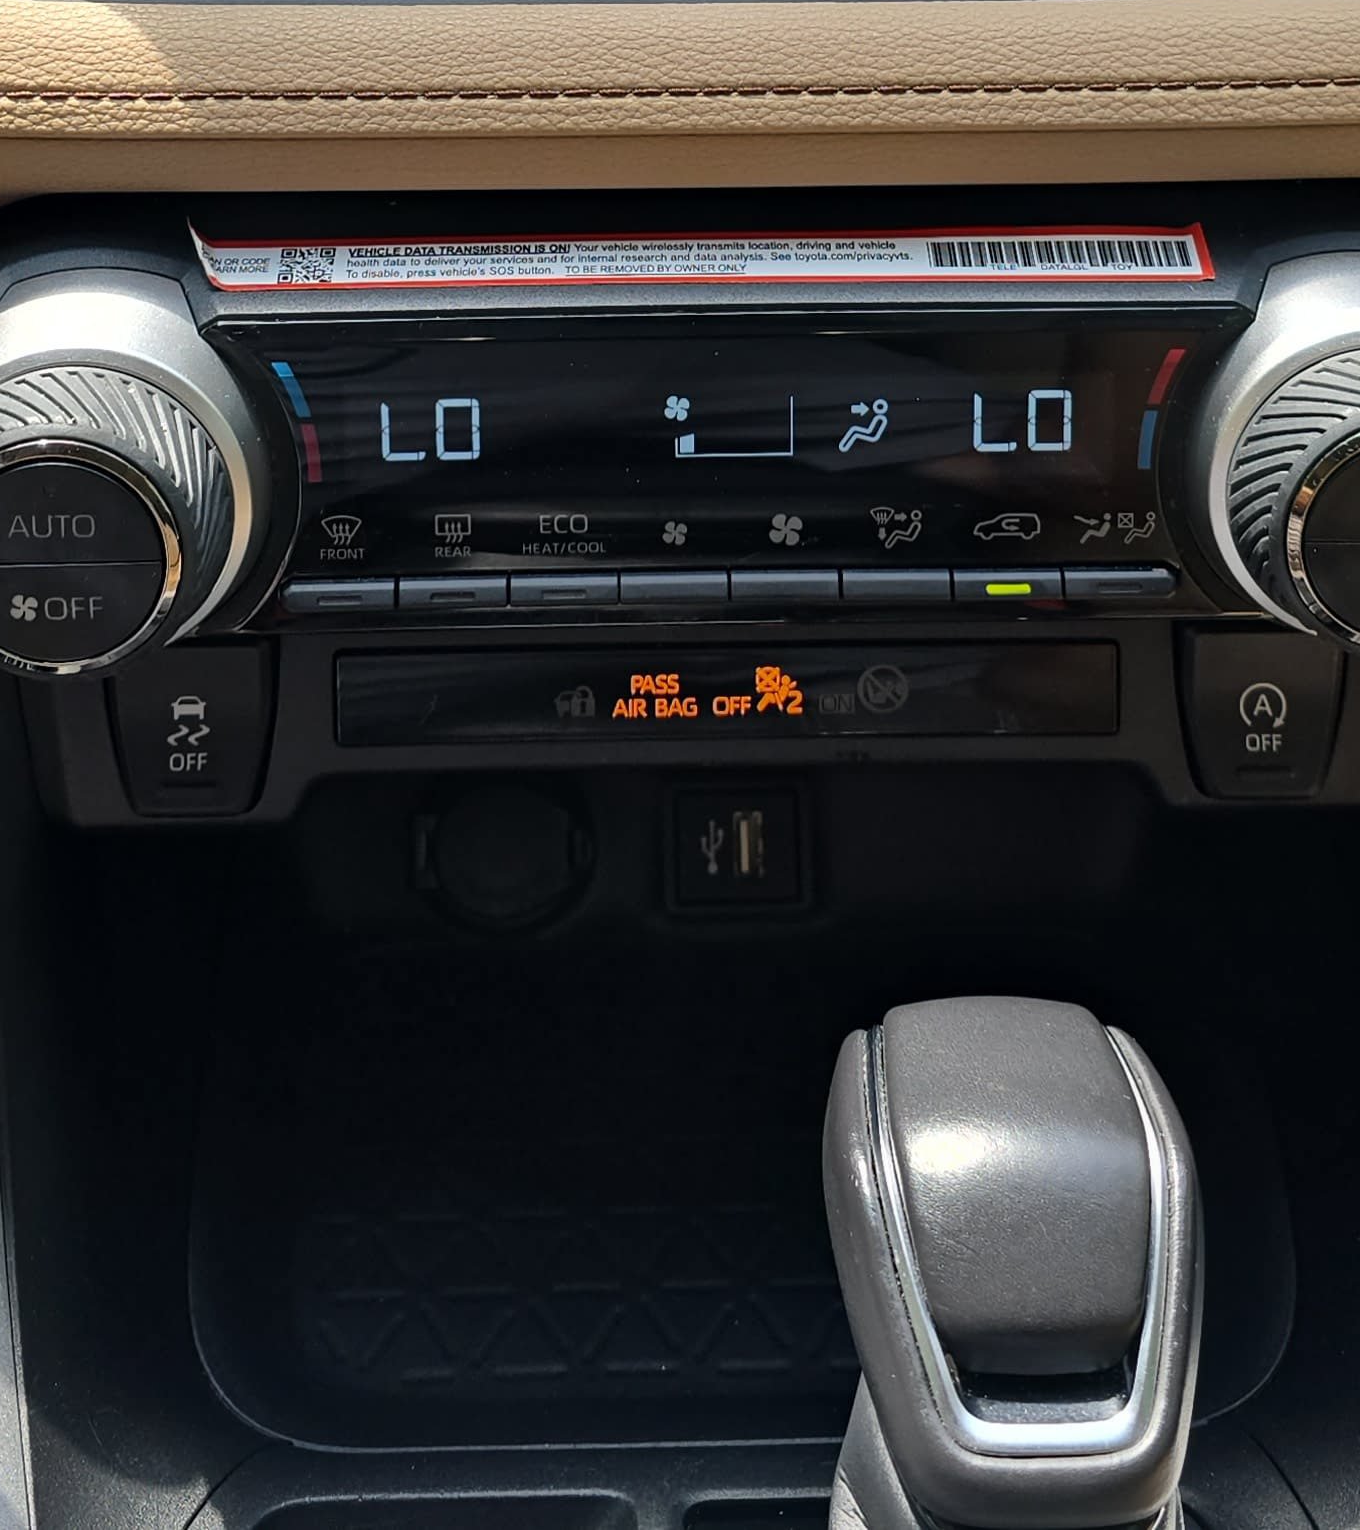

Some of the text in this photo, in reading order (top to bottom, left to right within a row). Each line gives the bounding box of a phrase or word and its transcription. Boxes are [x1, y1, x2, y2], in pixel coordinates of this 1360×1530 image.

[348, 246, 401, 258] VEHICLE
[404, 246, 437, 257] DATA
[438, 244, 532, 256] TRANSMISSION
[534, 243, 546, 254] IS
[574, 243, 599, 253] Your
[601, 242, 639, 252] vehicle
[642, 242, 694, 253] wirelessly
[696, 241, 746, 251] transmits
[748, 240, 793, 251] location,
[796, 240, 832, 251] driving
[835, 240, 855, 250] and
[858, 240, 896, 250] vehicle
[241, 257, 271, 266] CODE
[346, 258, 380, 268] health
[382, 258, 407, 267] data
[410, 257, 421, 266] to
[424, 257, 460, 266] deliver
[463, 257, 487, 267] your
[490, 255, 534, 265] services
[537, 255, 558, 264] and
[560, 254, 575, 263] for
[577, 254, 618, 263] internal
[621, 253, 668, 262] research
[670, 253, 691, 262] and
[693, 252, 718, 262] data
[720, 252, 768, 262] analysis.
[770, 251, 792, 261] See
[346, 263, 747, 279] To disable, press vehicle's SOS button. TO BE REMOVED BY OWNER ONLY
[379, 398, 482, 463] LO
[972, 388, 1073, 453] LO
[8, 514, 96, 539] AUTO
[539, 514, 589, 535] ECO
[320, 547, 365, 561] FRONT
[434, 546, 472, 559] REAR
[522, 540, 607, 556] HEAT/COOL
[44, 595, 103, 621] OFF
[629, 673, 680, 696] PASS
[611, 695, 752, 719] AIR BAG OFF
[1245, 733, 1283, 752] OFF
[168, 751, 209, 773] OFF
